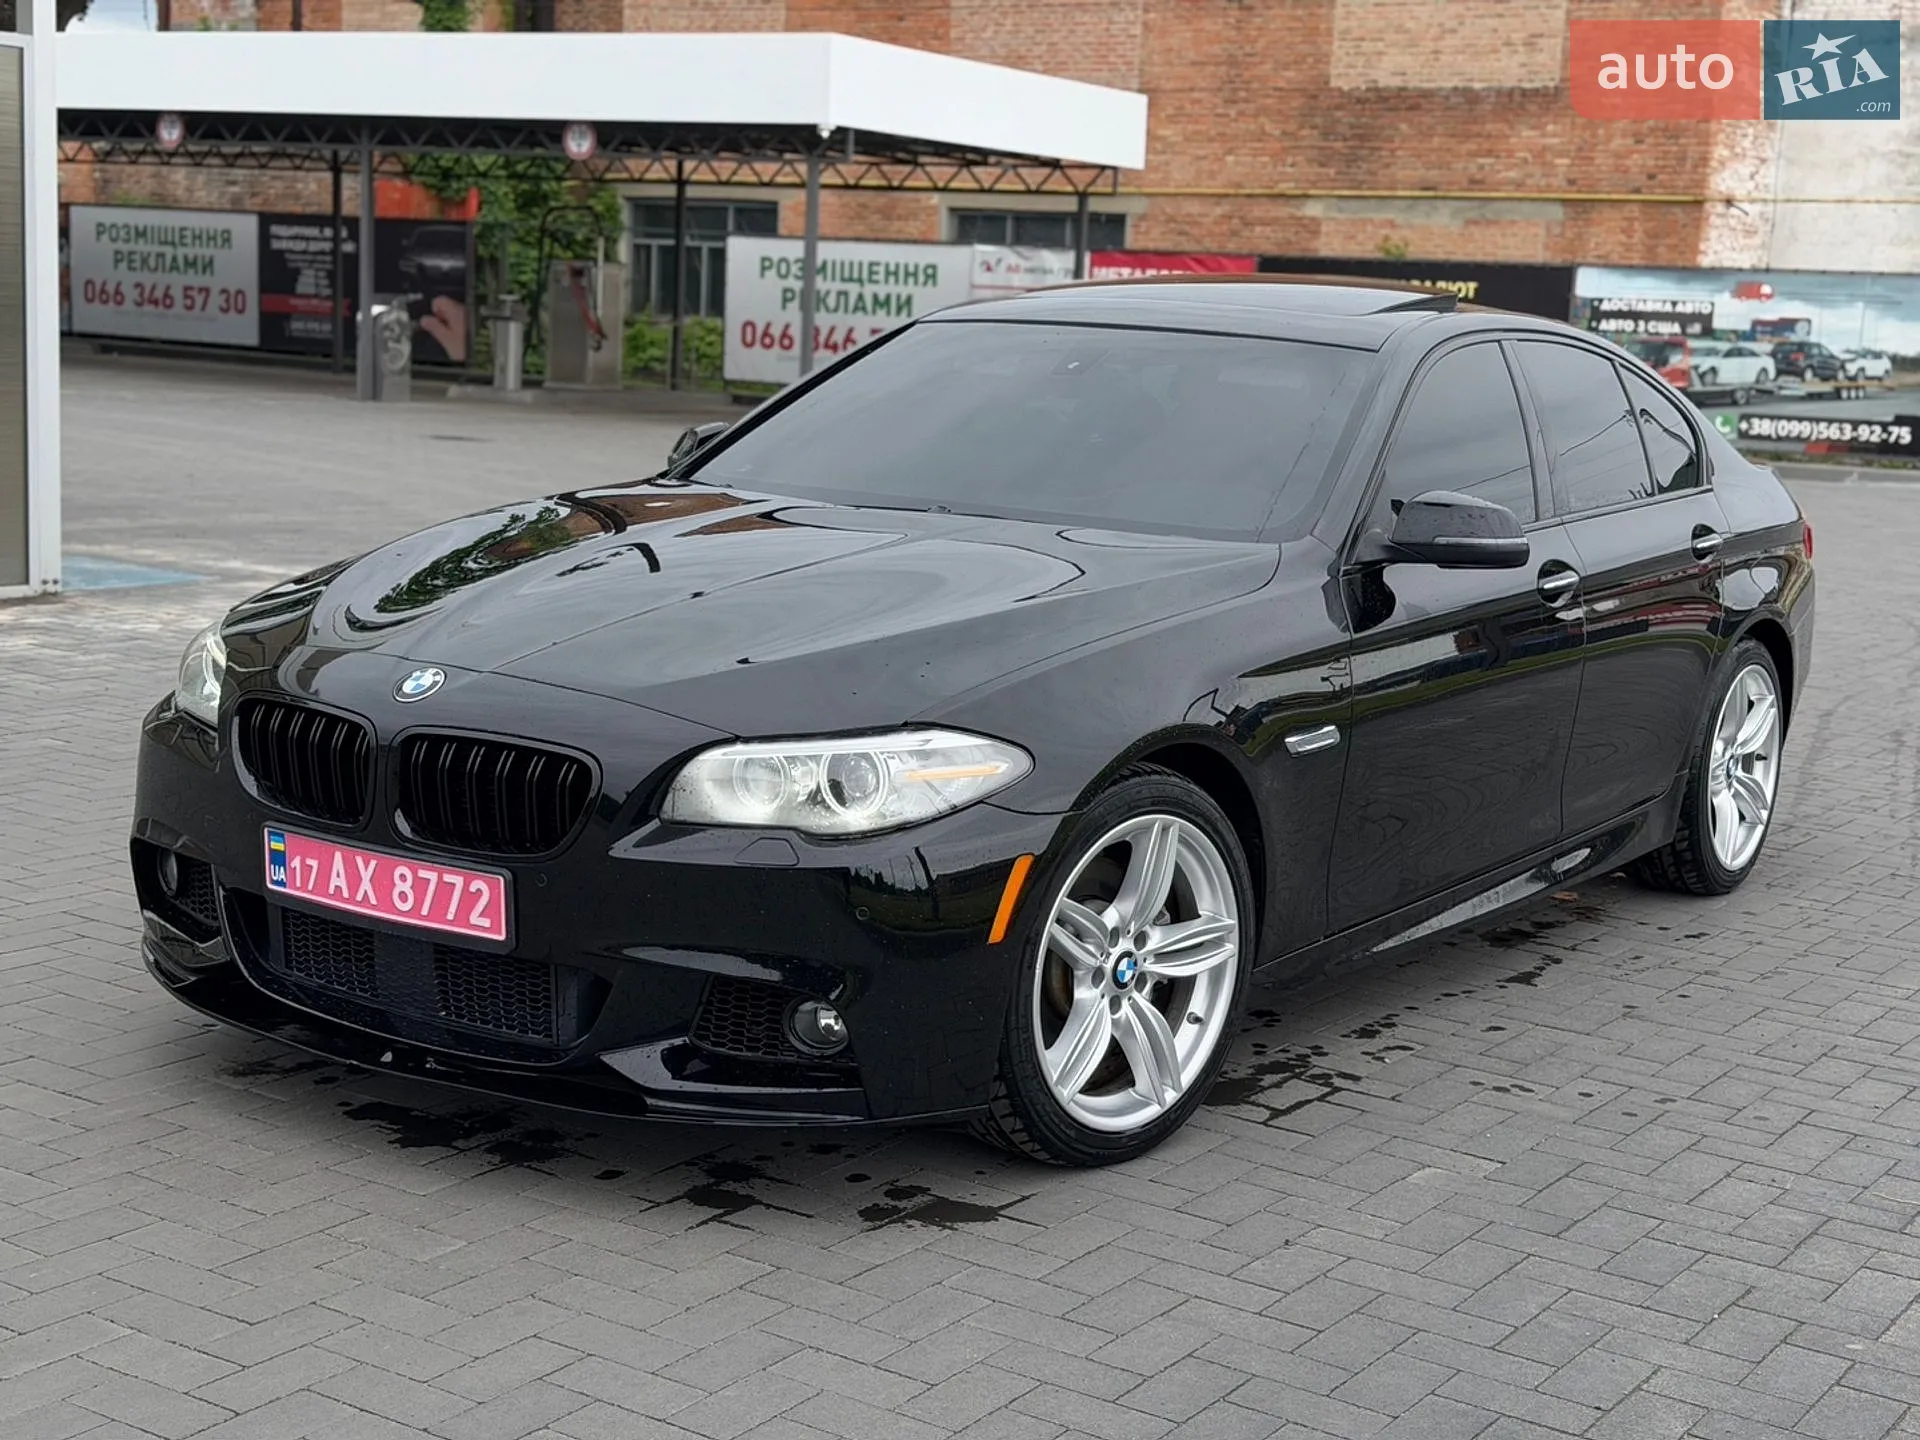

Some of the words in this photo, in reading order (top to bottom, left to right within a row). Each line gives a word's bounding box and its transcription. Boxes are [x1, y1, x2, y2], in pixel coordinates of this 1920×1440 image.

[94, 222, 233, 250] РОЗМІЩЕННЯ
[112, 249, 215, 278] РЕКЛАМИ
[84, 278, 125, 306] 066
[132, 281, 175, 310] 346
[182, 285, 211, 312] 57
[217, 287, 247, 315] 30
[781, 287, 914, 318] РКЛАМИ
[1675, 301, 1713, 315] АВТО
[740, 320, 795, 352] 066
[1598, 318, 1635, 332] АВТО
[1738, 416, 1913, 445] +38(099)563-92-75
[270, 863, 287, 883] UA
[289, 854, 320, 891] 17
[327, 850, 379, 906] AX
[391, 865, 493, 929] 8772
